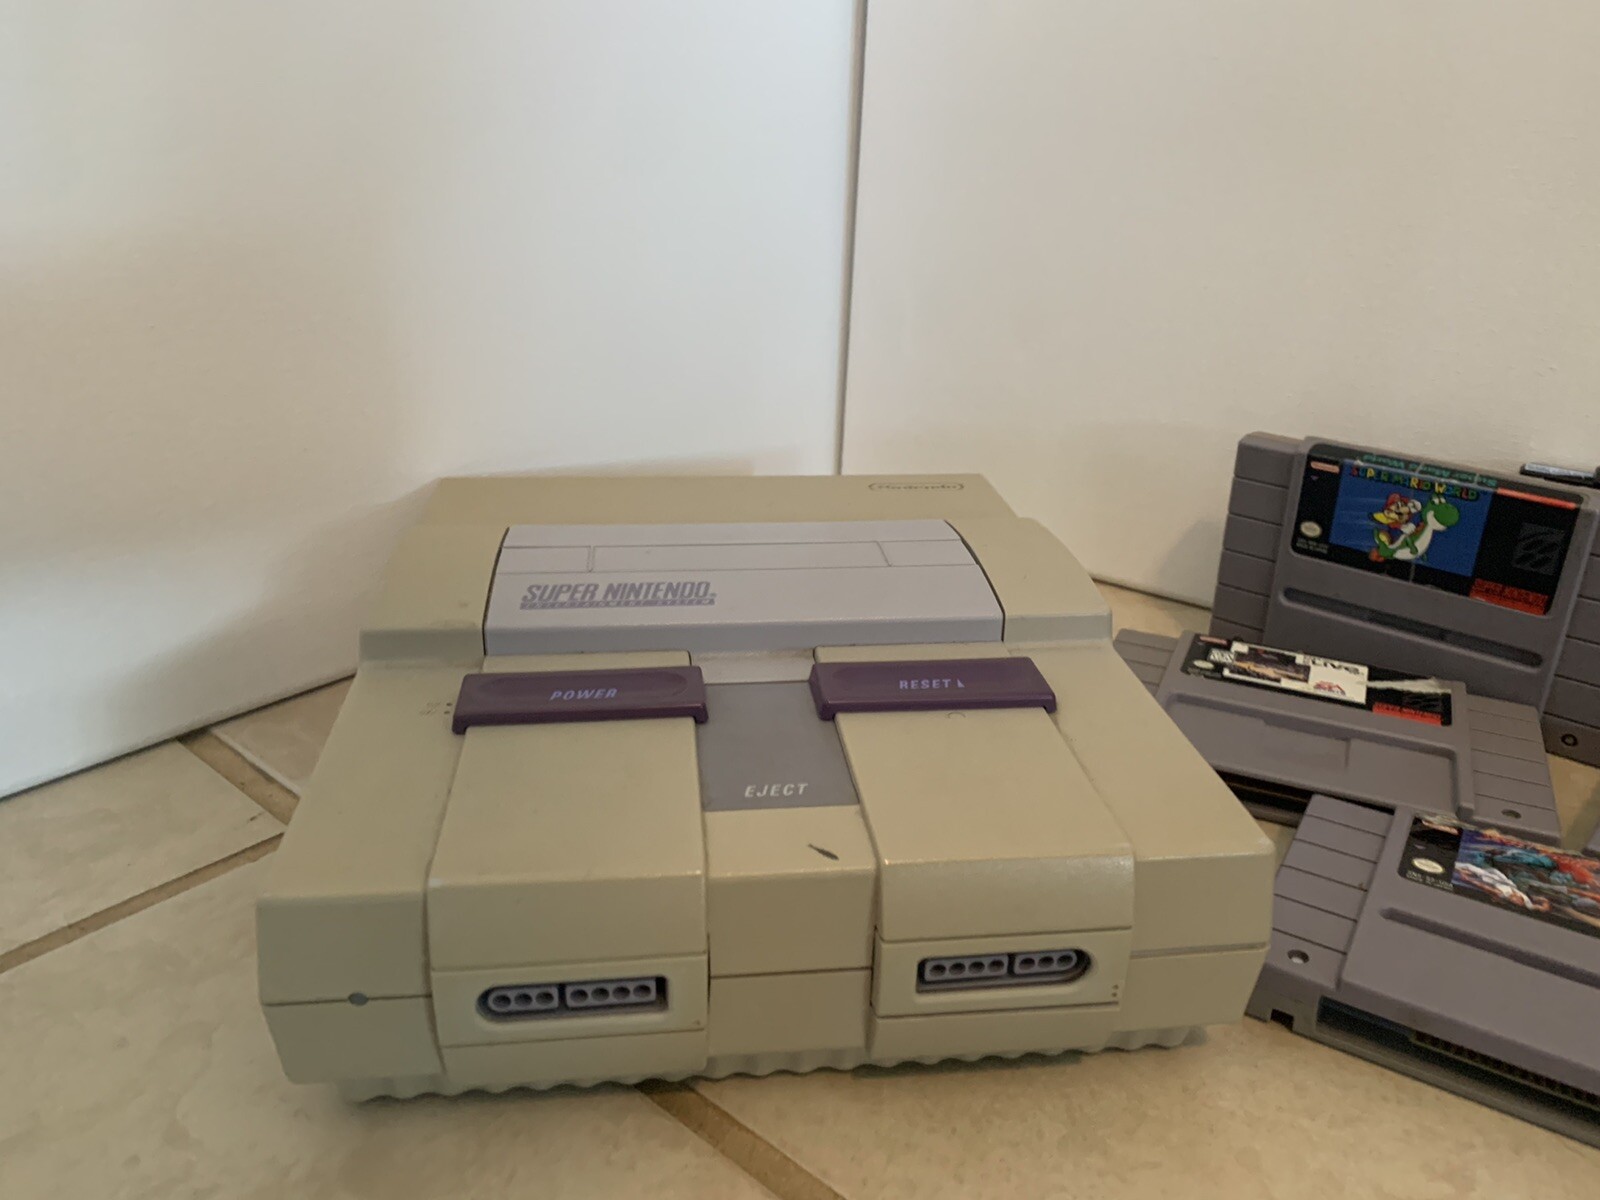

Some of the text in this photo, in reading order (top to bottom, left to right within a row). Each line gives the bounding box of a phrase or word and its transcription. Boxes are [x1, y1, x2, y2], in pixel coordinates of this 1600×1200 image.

[1434, 481, 1479, 501] WORLD
[522, 581, 711, 601] SUPER NINTENDO
[899, 679, 952, 690] RESET
[549, 687, 618, 701] POWER
[744, 782, 809, 798] EJECT
